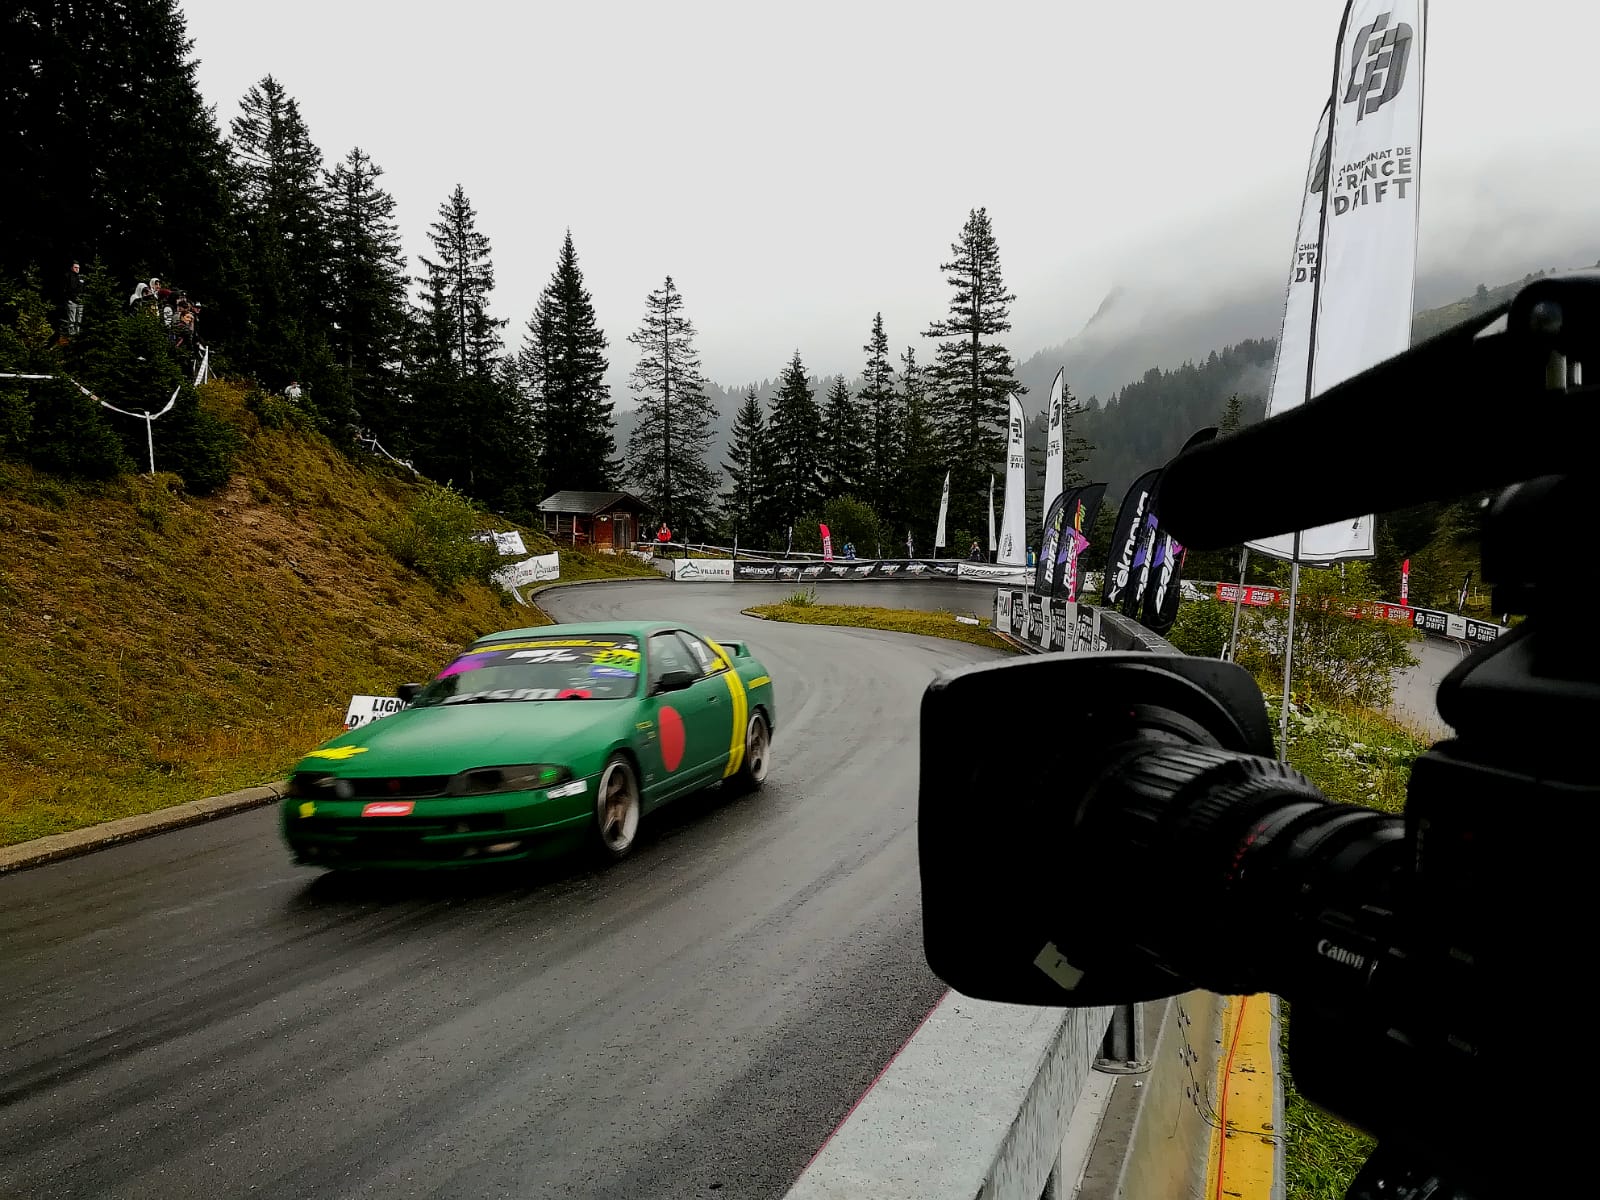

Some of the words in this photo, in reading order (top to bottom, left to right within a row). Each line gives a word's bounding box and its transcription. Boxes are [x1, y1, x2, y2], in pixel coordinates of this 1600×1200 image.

[1396, 147, 1412, 156] DE
[1425, 621, 1445, 631] DRIFT
[1316, 938, 1365, 970] Canon
